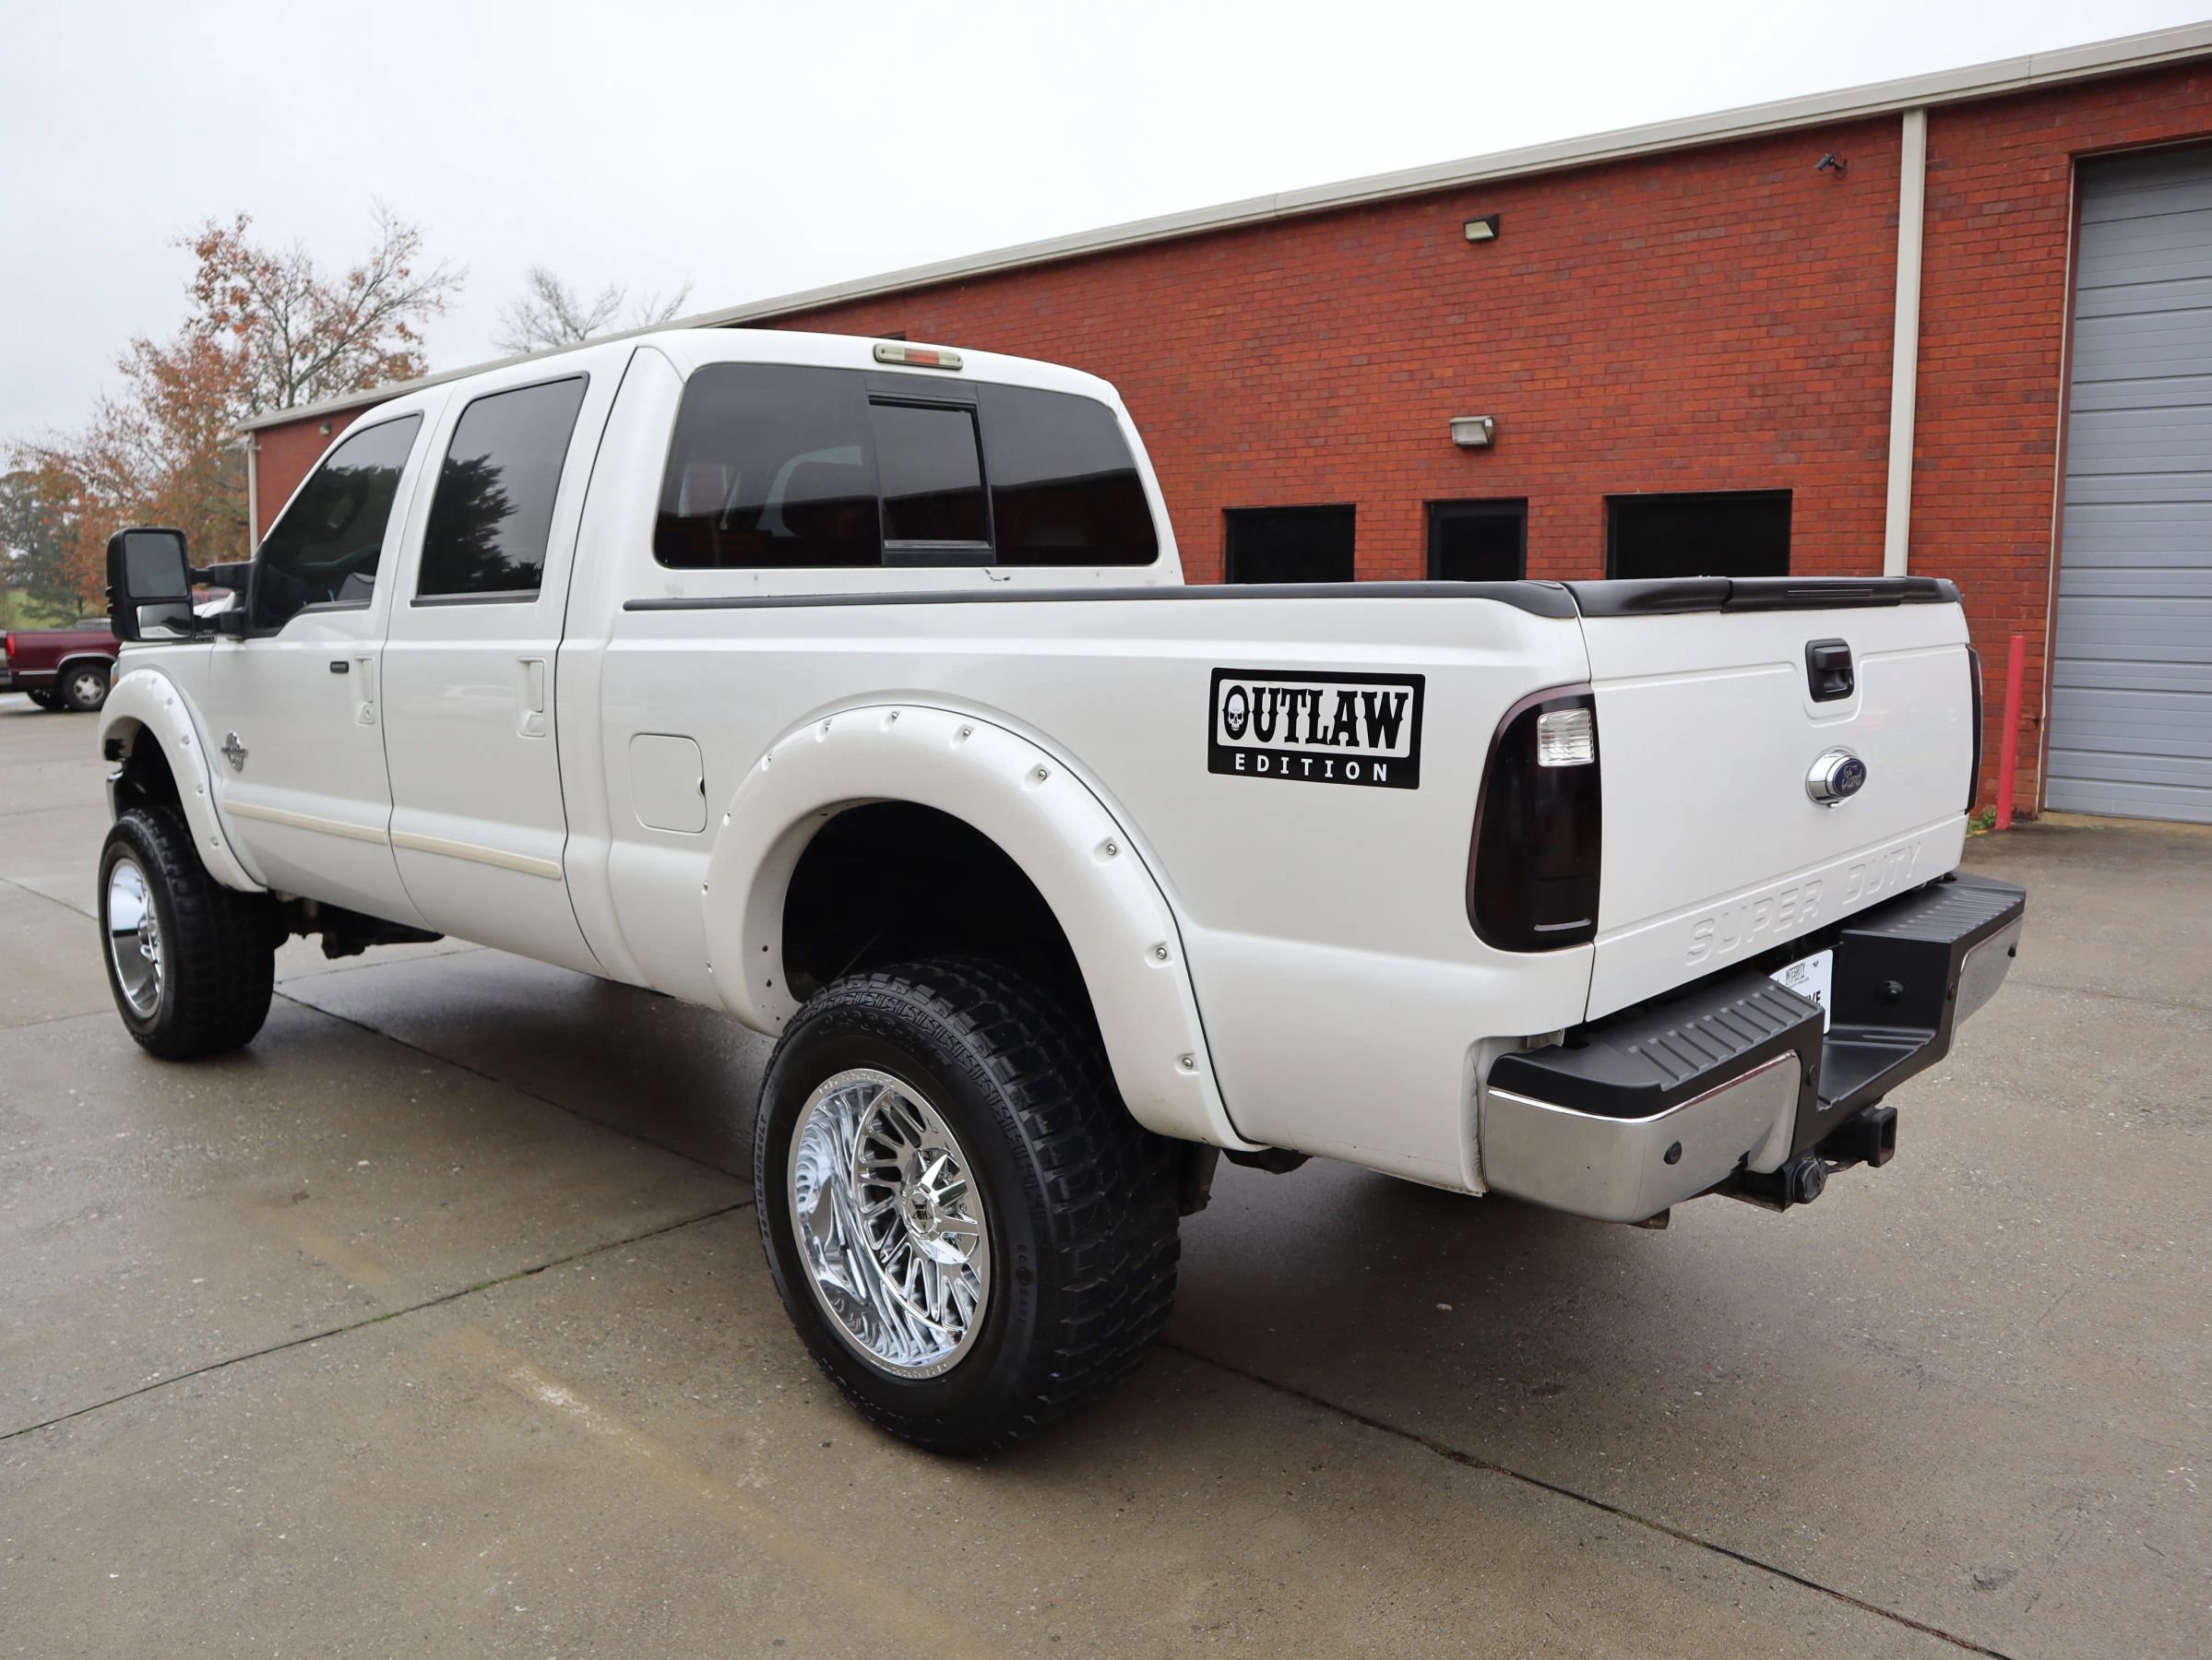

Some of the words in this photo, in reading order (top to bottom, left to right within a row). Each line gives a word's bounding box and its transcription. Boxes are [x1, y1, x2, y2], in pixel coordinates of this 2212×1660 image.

[1222, 685, 1409, 749] OUTLAW
[1235, 753, 1387, 782] EDITION
[1841, 765, 1862, 790] Ford
[1684, 879, 1824, 966] SUPER
[1843, 842, 1922, 906] DUTY
